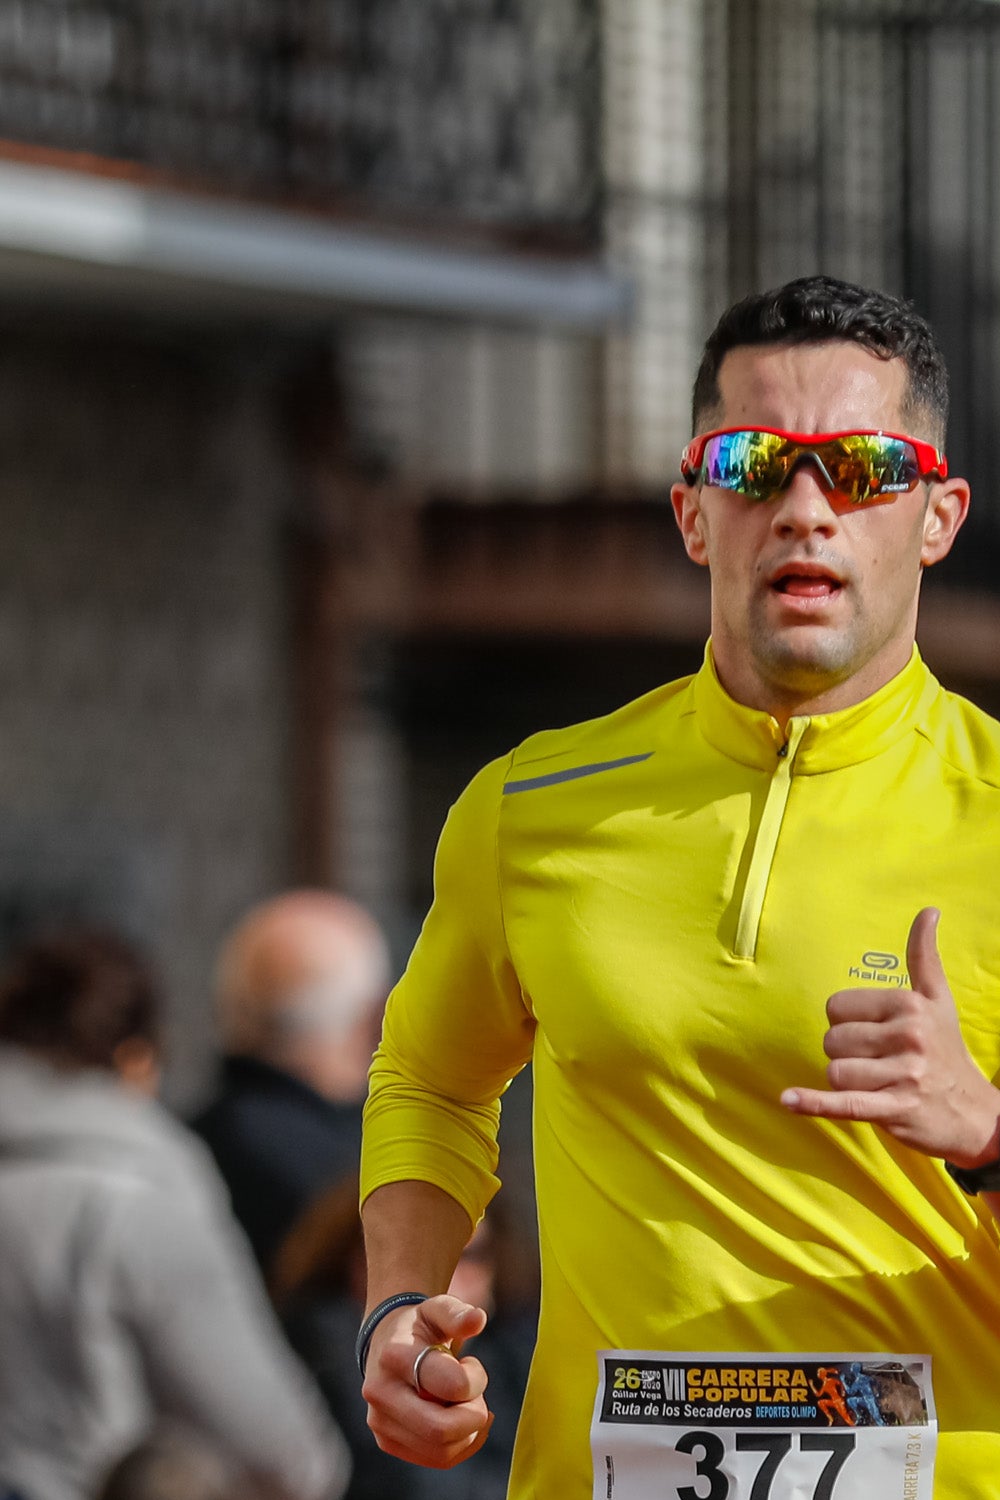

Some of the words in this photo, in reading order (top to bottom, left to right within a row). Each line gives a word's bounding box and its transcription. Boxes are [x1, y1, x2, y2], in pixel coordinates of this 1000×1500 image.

[848, 966, 909, 988] Kalenji
[613, 1367, 641, 1390] 26
[642, 1381, 661, 1391] 2020
[662, 1368, 686, 1401] VII
[687, 1368, 808, 1387] CARRERA
[612, 1389, 638, 1399] Cúllar
[640, 1391, 662, 1401] Vega
[688, 1388, 809, 1402] POPULAR
[612, 1402, 642, 1416] Ruta
[644, 1403, 660, 1416] de
[662, 1404, 680, 1417] los
[684, 1404, 752, 1419] Secaderos
[755, 1406, 790, 1419] DEPORTES
[791, 1406, 817, 1419] OLIMPO
